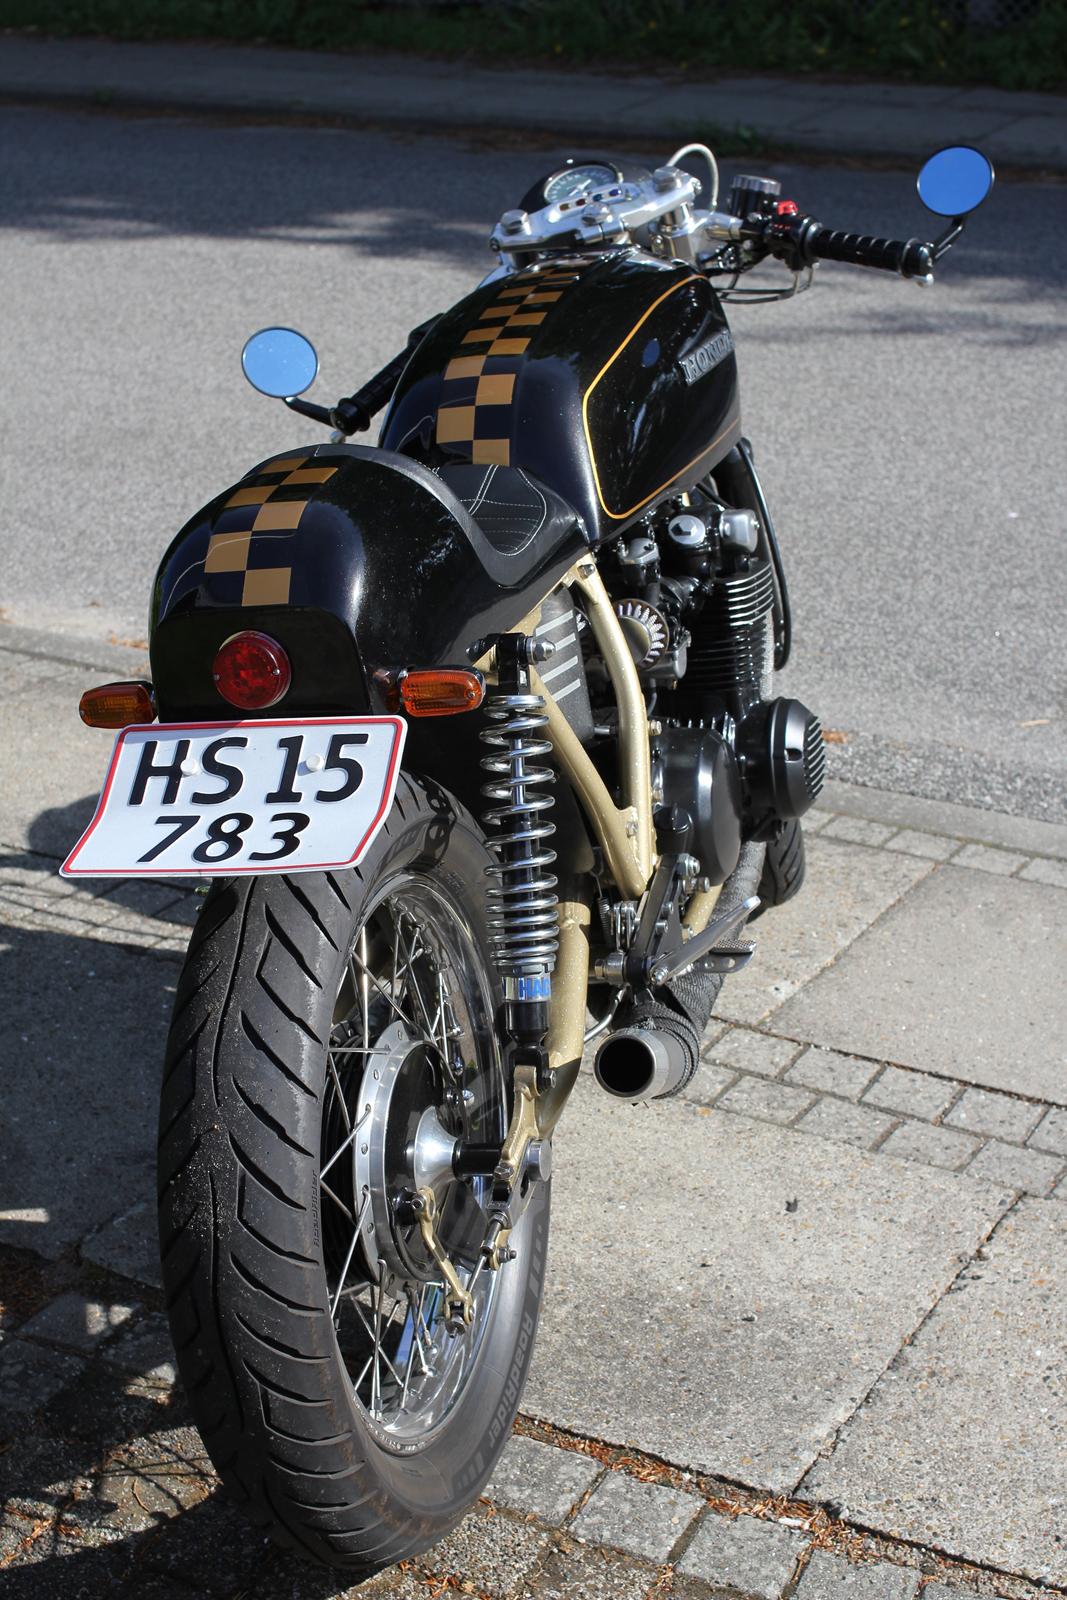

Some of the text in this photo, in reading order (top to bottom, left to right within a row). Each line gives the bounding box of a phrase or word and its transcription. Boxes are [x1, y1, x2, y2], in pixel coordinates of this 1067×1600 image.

[128, 733, 369, 805] HS 15
[136, 812, 310, 863] 783
[489, 1311, 534, 1449] RoadRider
